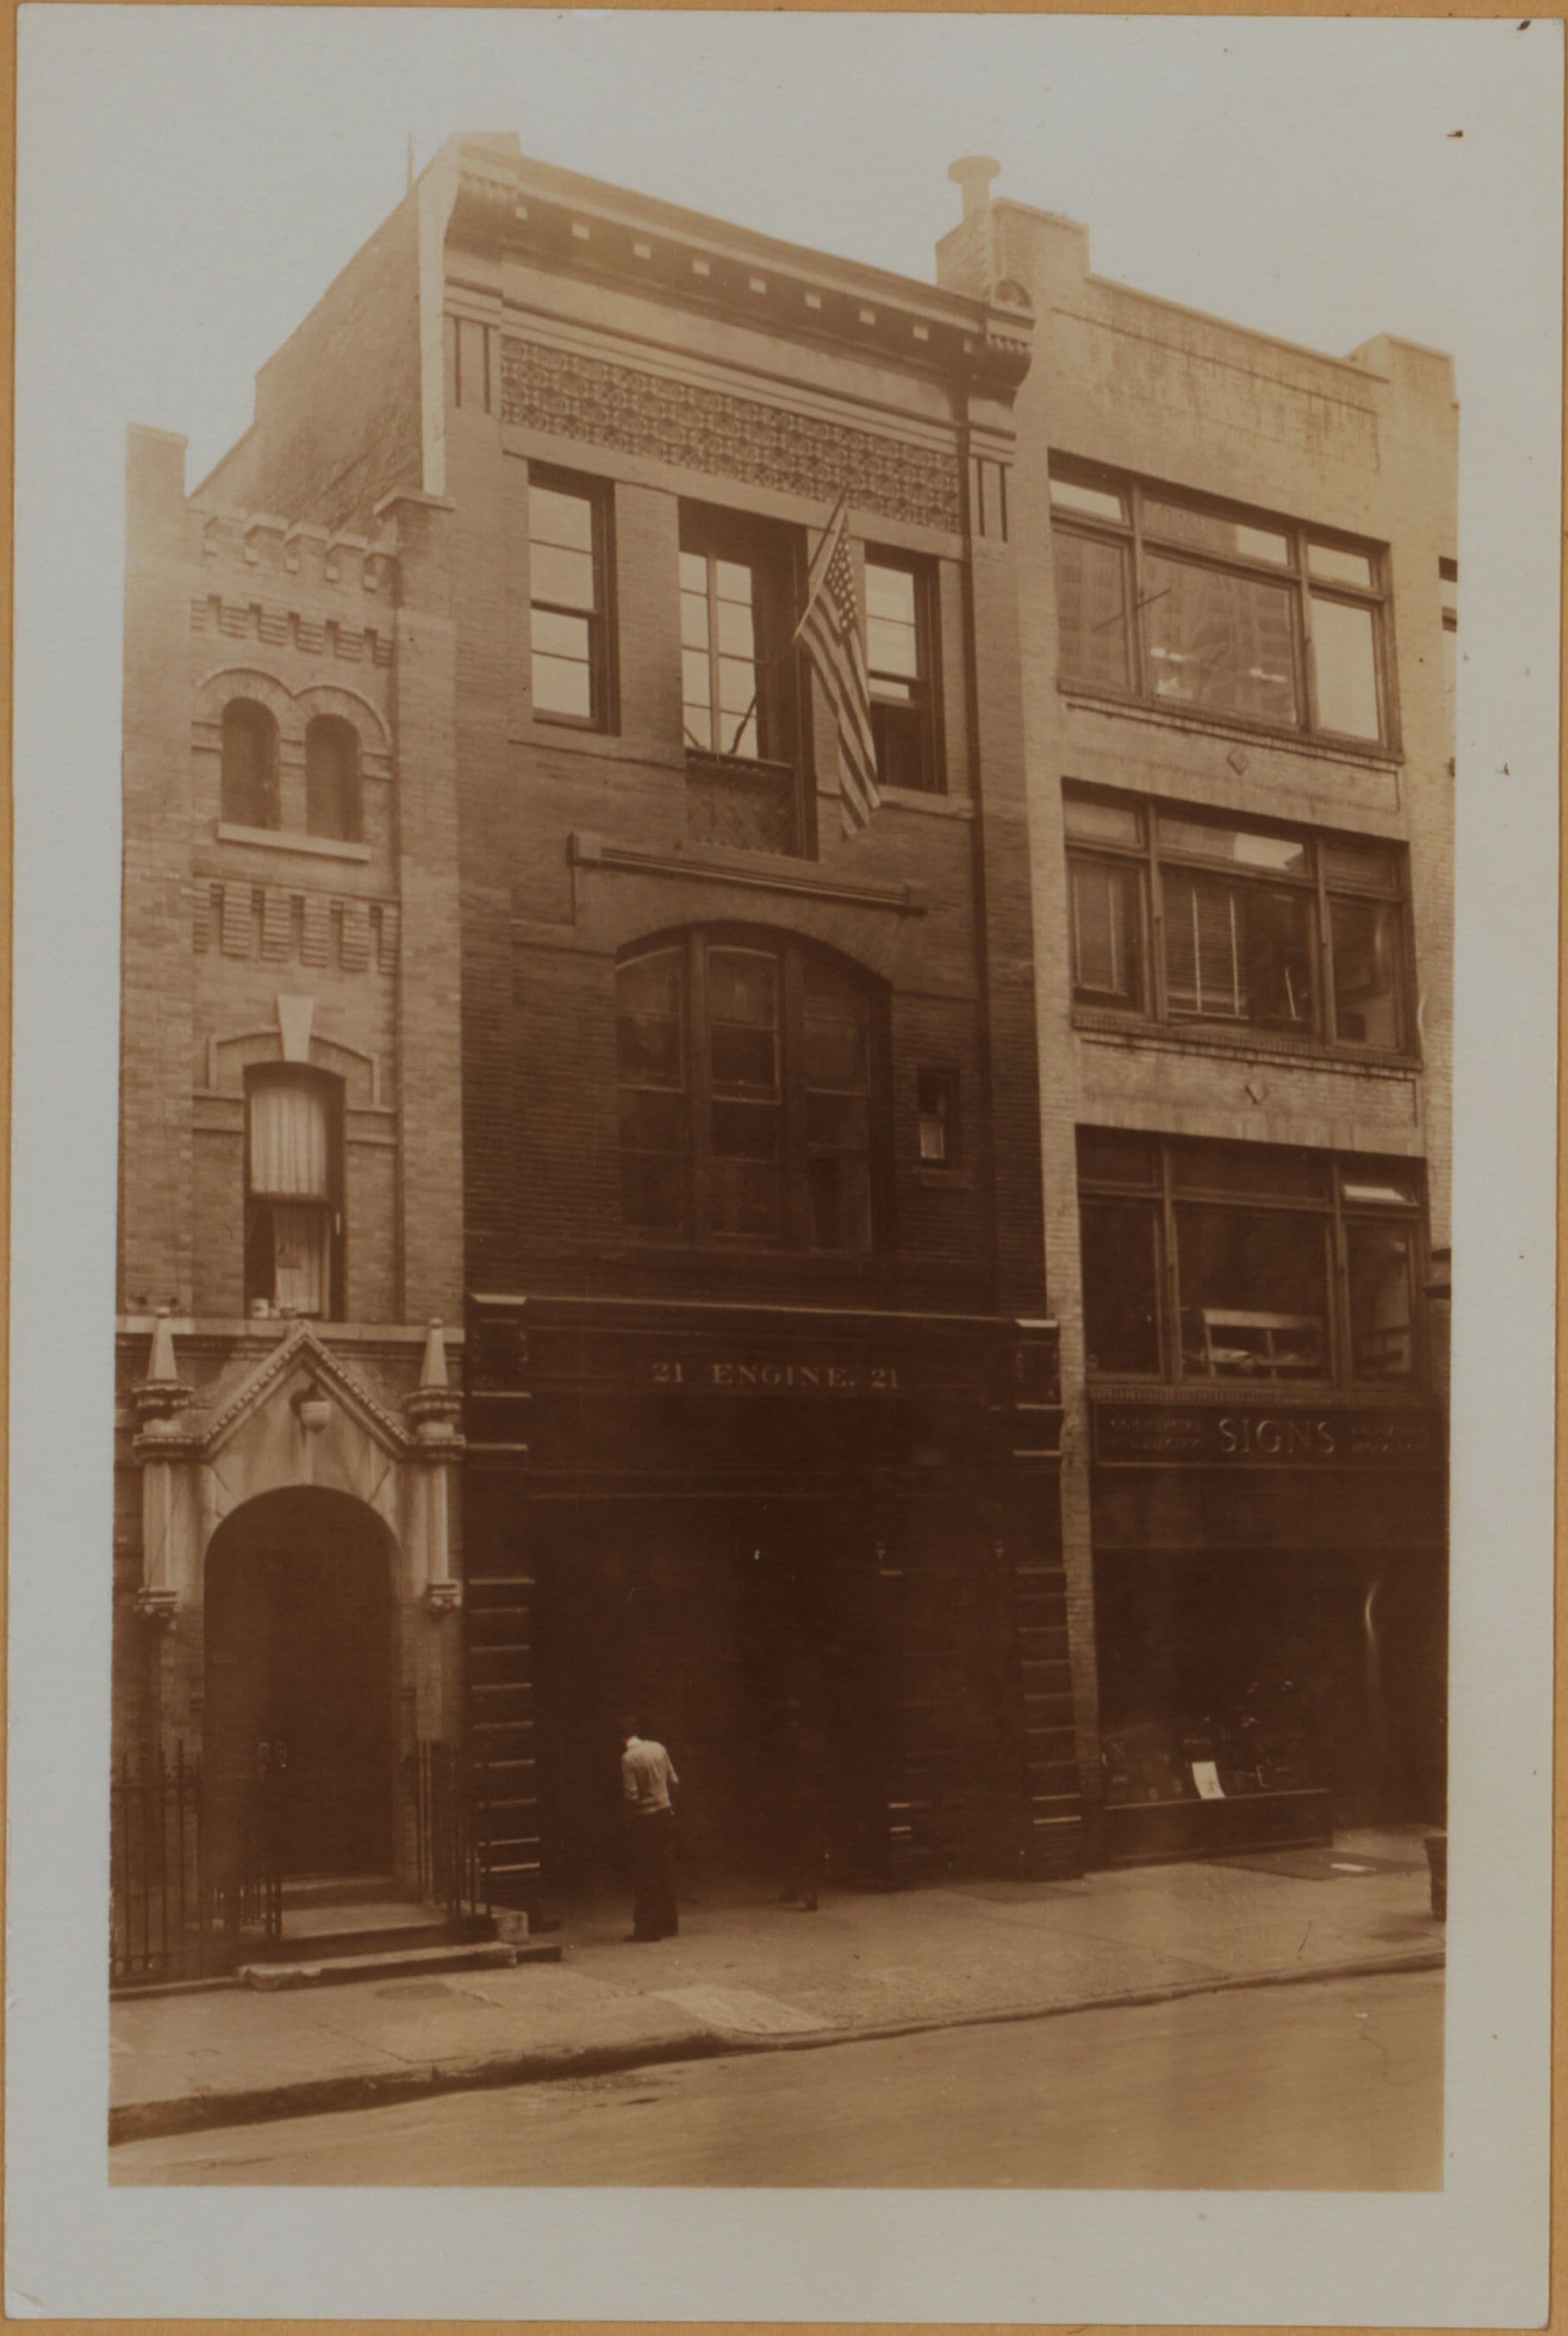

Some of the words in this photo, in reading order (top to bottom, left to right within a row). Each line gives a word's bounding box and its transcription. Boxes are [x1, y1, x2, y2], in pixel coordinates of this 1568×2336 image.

[652, 1363, 684, 1384] 21
[871, 1368, 899, 1389] 21
[1218, 1417, 1336, 1455] SIGNS
